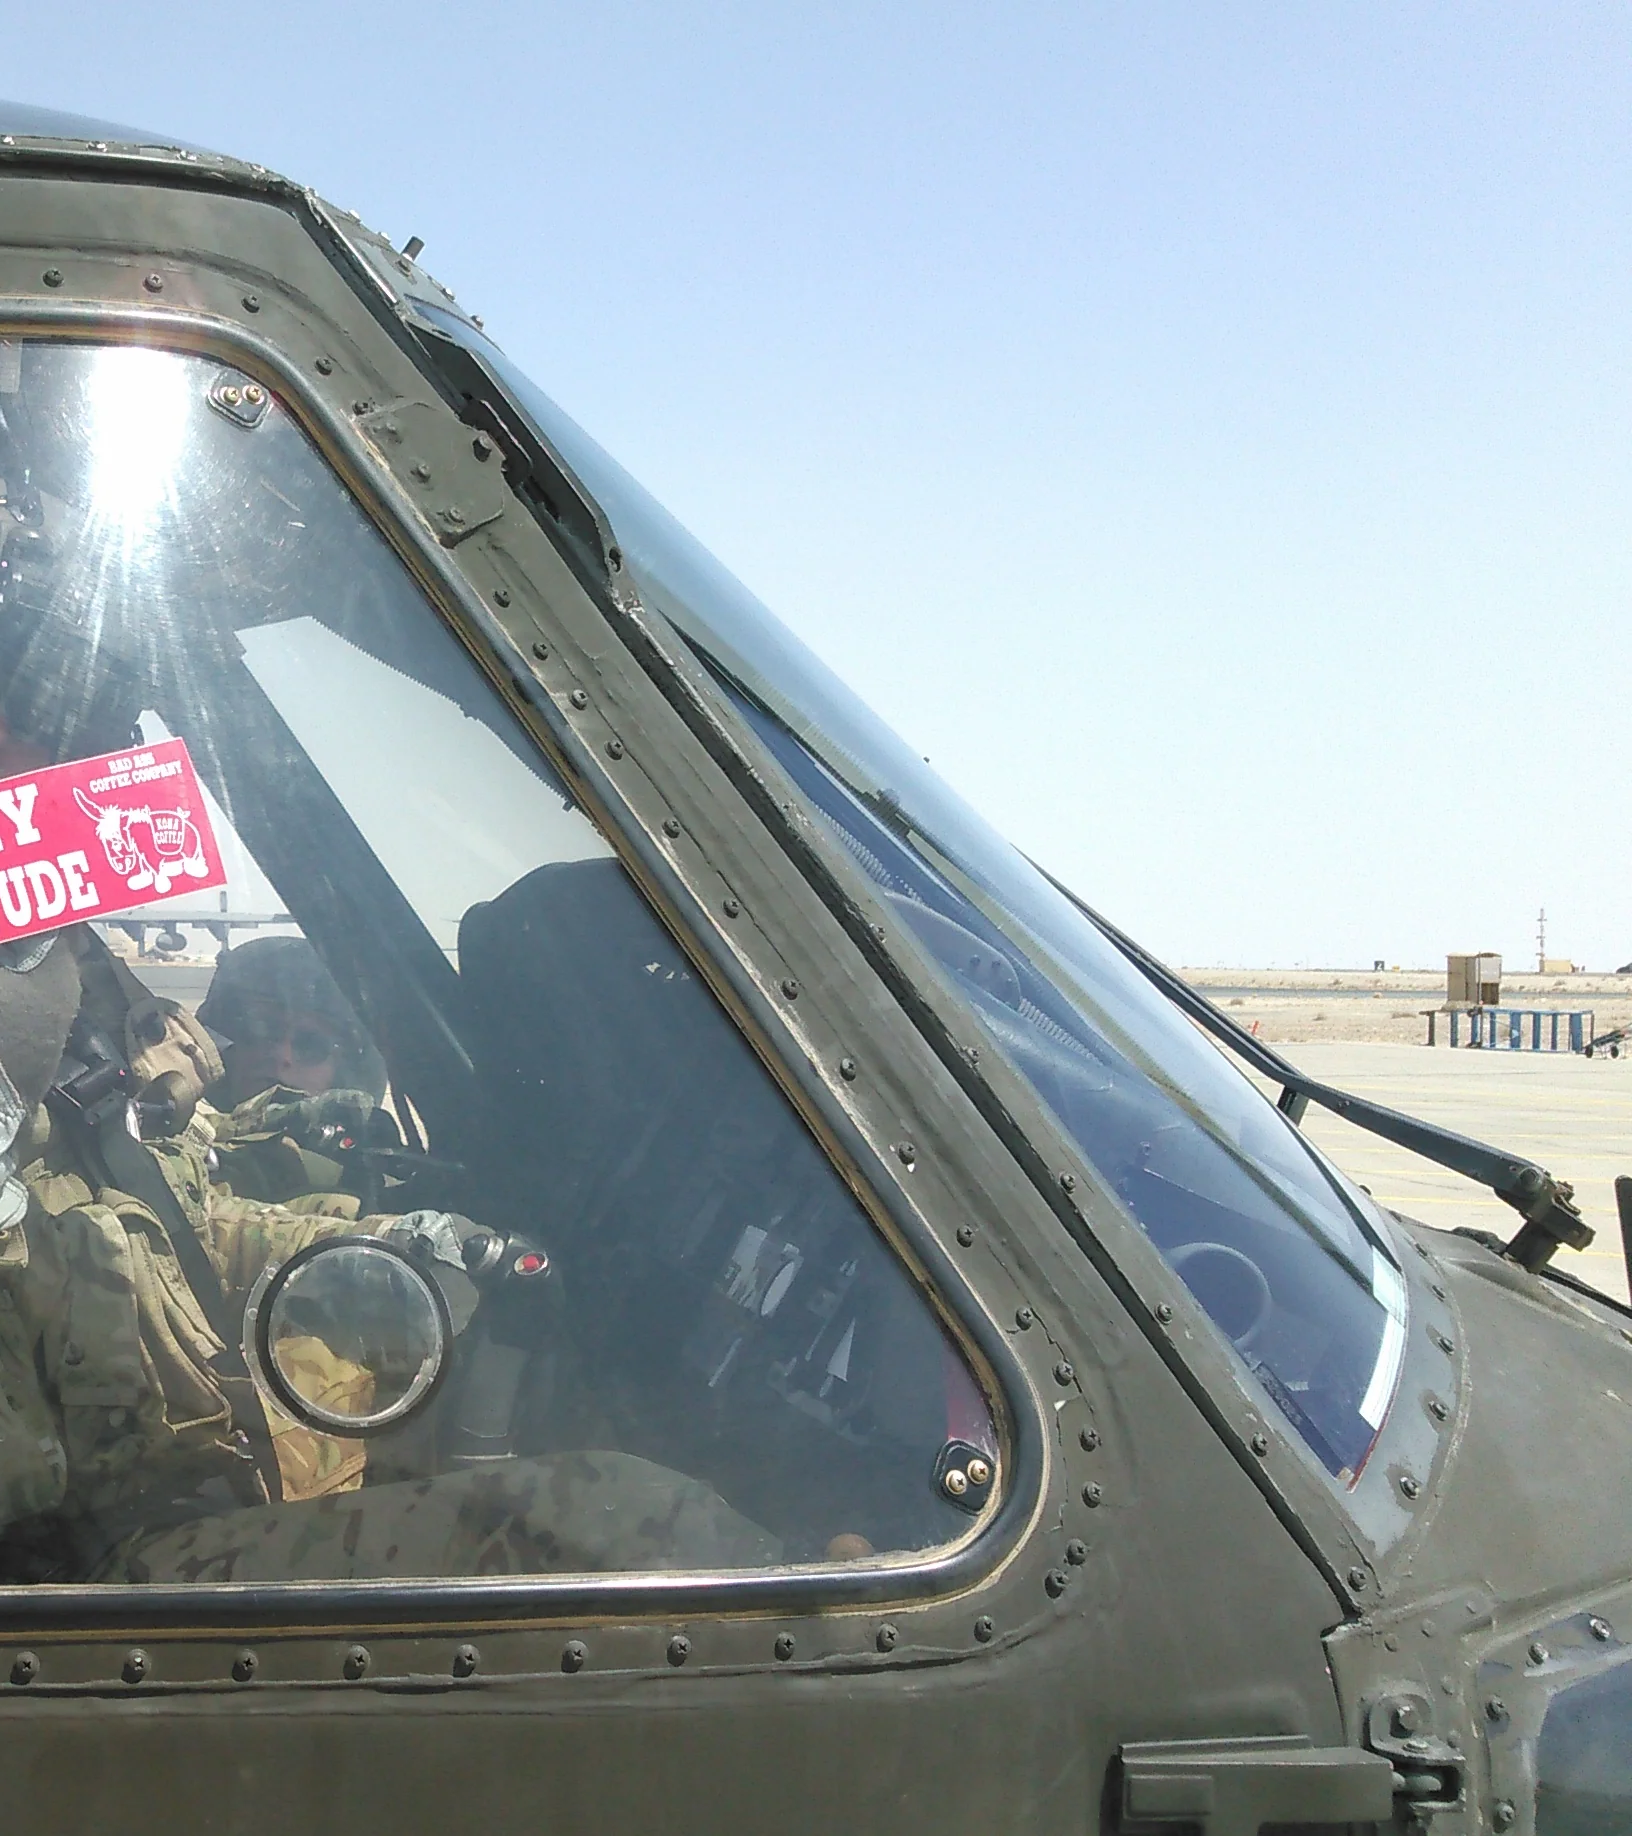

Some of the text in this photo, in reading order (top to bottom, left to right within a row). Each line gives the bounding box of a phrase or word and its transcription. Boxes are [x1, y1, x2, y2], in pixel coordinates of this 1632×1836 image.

[108, 753, 155, 773] BAD ASS
[89, 761, 182, 793] COFFEE COMPANY
